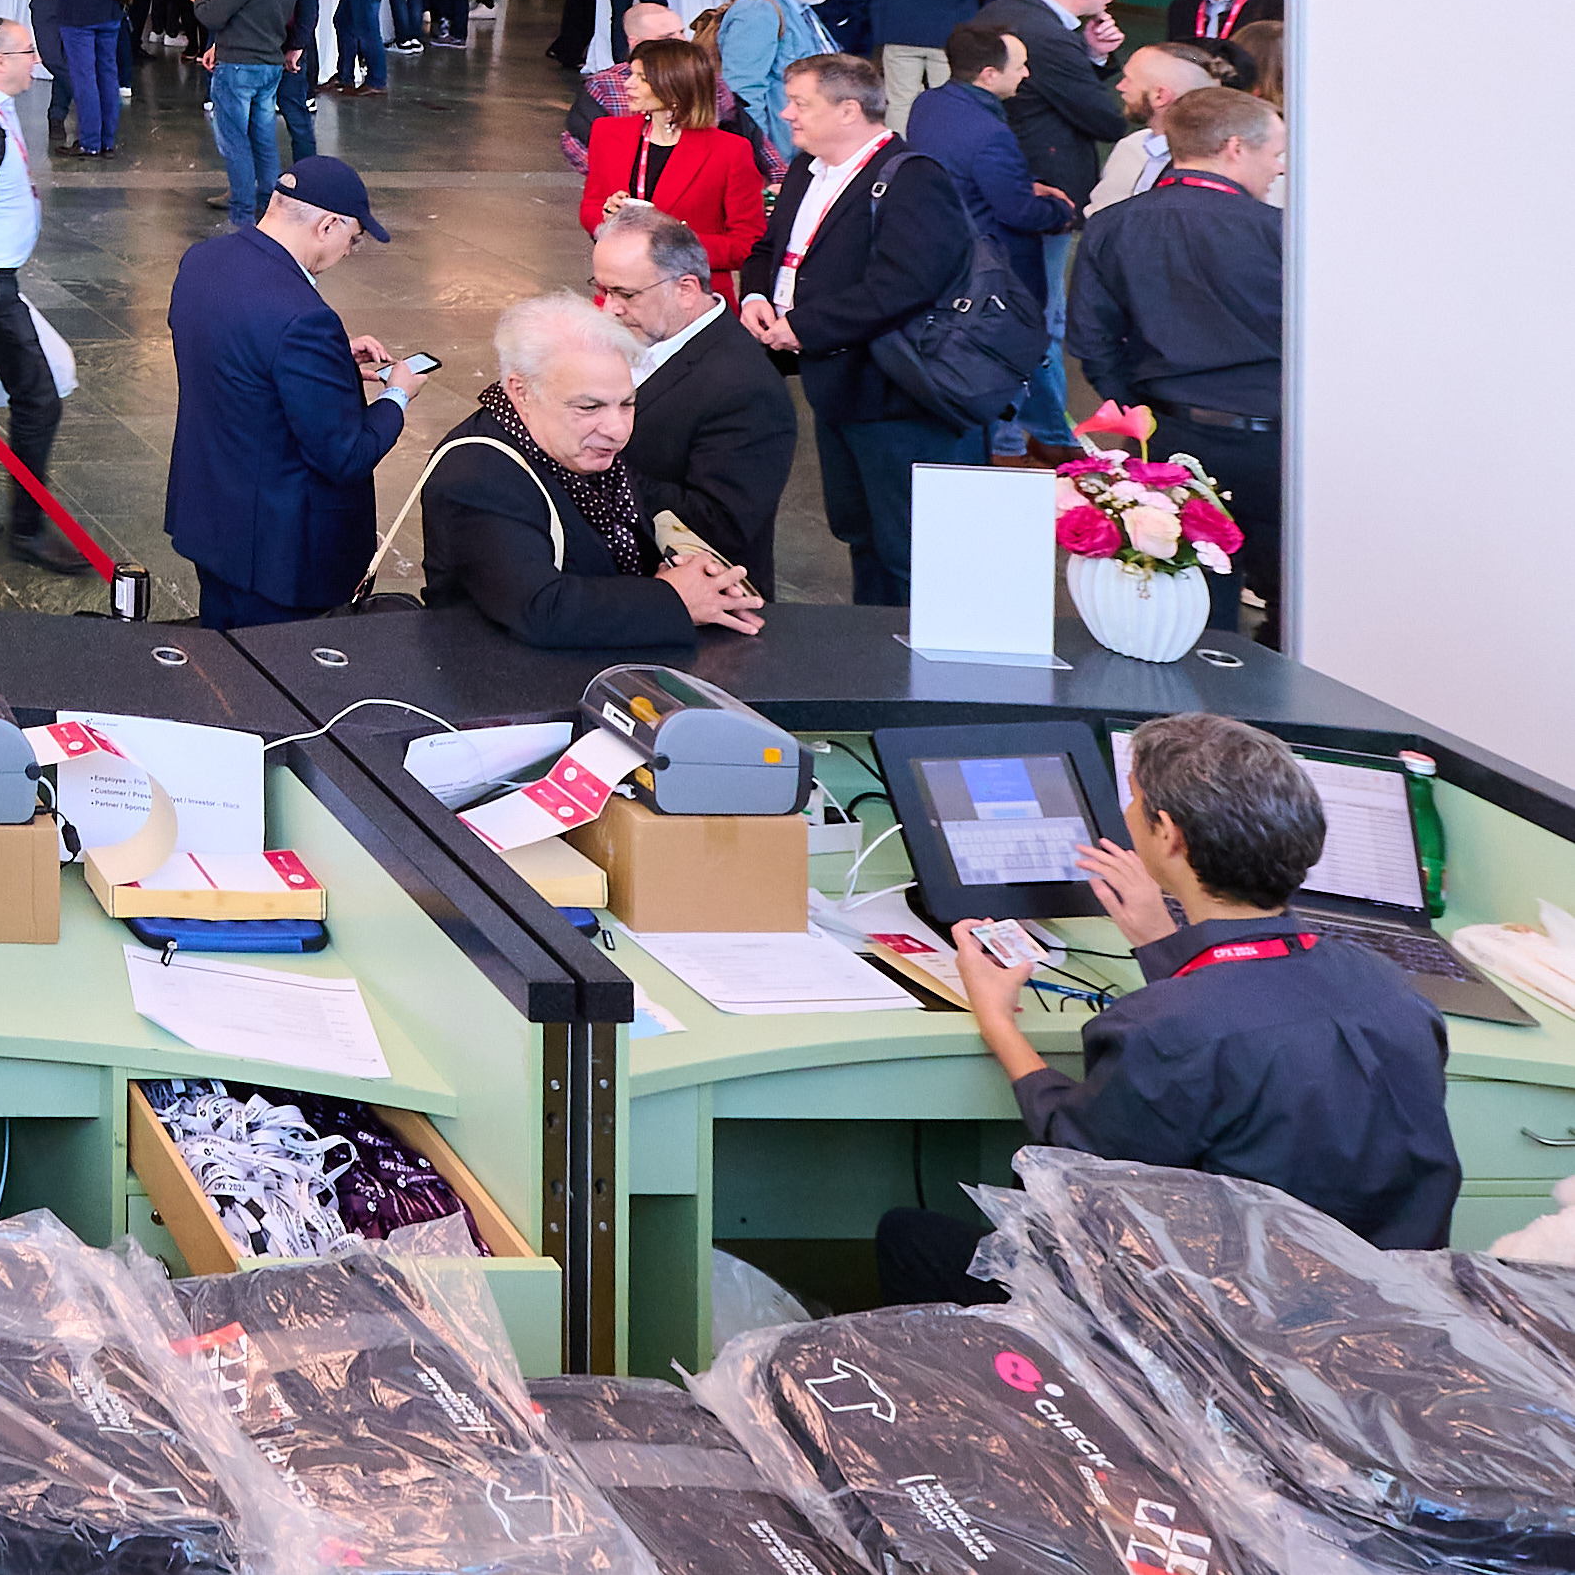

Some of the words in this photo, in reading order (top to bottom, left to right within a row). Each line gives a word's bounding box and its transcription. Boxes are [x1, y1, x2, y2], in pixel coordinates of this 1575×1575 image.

[94, 775, 126, 784] Employee
[95, 787, 126, 796] Customer
[188, 798, 215, 807] Investor
[95, 800, 118, 809] Partner
[125, 803, 151, 812] Sponso
[357, 1130, 374, 1145] CPX
[379, 1160, 395, 1171] CPX
[229, 1183, 246, 1192] 2024
[416, 1371, 438, 1392] LIFE
[433, 1394, 463, 1424] TRAVEL
[1035, 1399, 1118, 1473] CHECK
[905, 1486, 947, 1531] POUCH
[933, 1483, 971, 1526] TRAVEL
[970, 1527, 997, 1553] LIFE
[917, 1483, 989, 1562] IN-LUGGAGE
